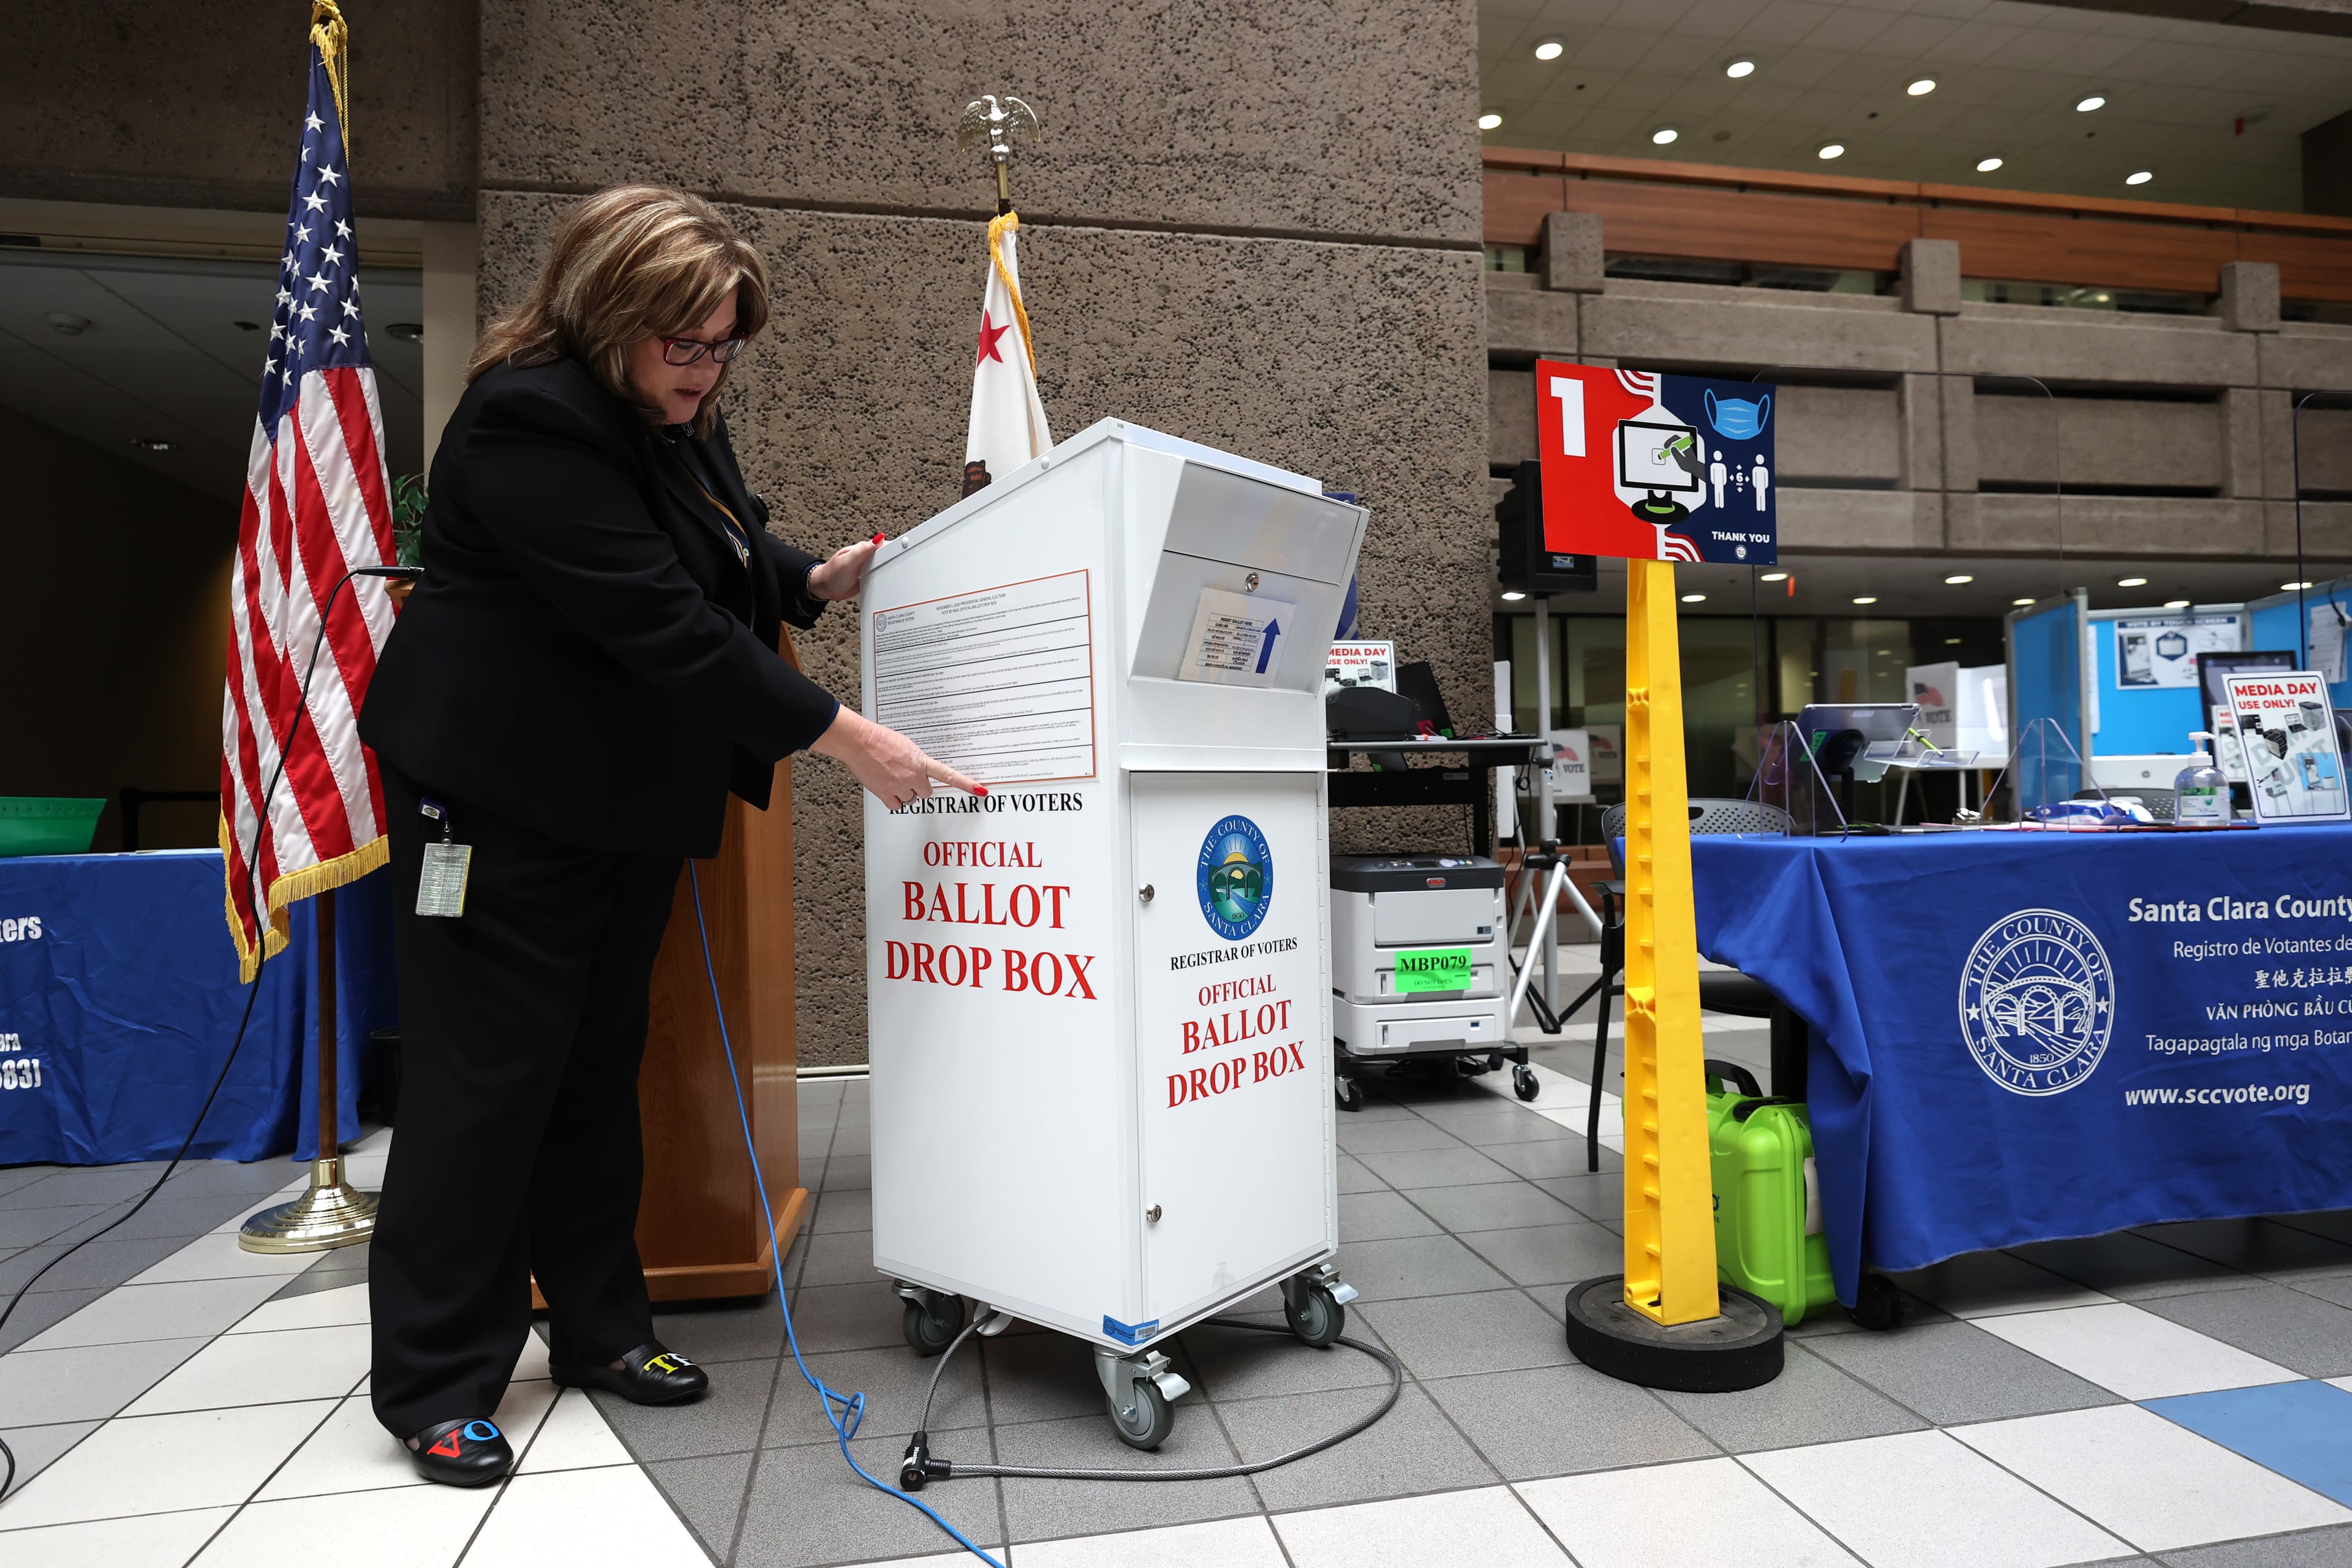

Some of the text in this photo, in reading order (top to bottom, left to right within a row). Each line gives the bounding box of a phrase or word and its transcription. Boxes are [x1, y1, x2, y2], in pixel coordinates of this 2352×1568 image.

[1550, 375, 1586, 457] 1
[1736, 472, 1743, 482] 6
[1711, 531, 1770, 543] THANK YOU
[2234, 683, 2316, 696] MEDIA DAY
[1926, 709, 1951, 723] VOTE
[2238, 699, 2296, 709] USE ONLY!
[1563, 764, 1585, 773] VOTE
[984, 794, 1007, 813] OF
[1011, 792, 1083, 812] VOTERS
[924, 842, 1042, 868] OFFICIAL
[1200, 820, 1270, 869] THE COUNTY OF
[902, 881, 1070, 929] BALLOT
[1204, 895, 1270, 937] SANTA CLARA
[2128, 897, 2201, 922] Santa
[2207, 895, 2269, 921] Clara
[1170, 937, 1298, 971] REGISTRAR OF VOTERS
[1969, 918, 2107, 988] THE COUNTY OF
[2174, 934, 2352, 962] Registro de Votantes de
[884, 940, 1098, 1000] DROP BOX
[1400, 955, 1467, 972] MBP079
[1198, 974, 1277, 1006] OFFICIAL
[2206, 1002, 2237, 1021] VĂN
[2243, 999, 2298, 1019] PHÒNG
[2304, 994, 2334, 1016] BẦU
[1181, 999, 1291, 1055] BALLOT
[2146, 1033, 2248, 1055] Tagapagtala
[2252, 1035, 2271, 1052] ng
[2275, 1033, 2309, 1051] mga
[1976, 1029, 2105, 1088] SANTA CLARA
[2030, 1053, 2055, 1064] 1850
[1167, 1041, 1305, 1109] DROP BOX
[2125, 1084, 2310, 1106] www.sccvote.org
[427, 1420, 499, 1458] VO
